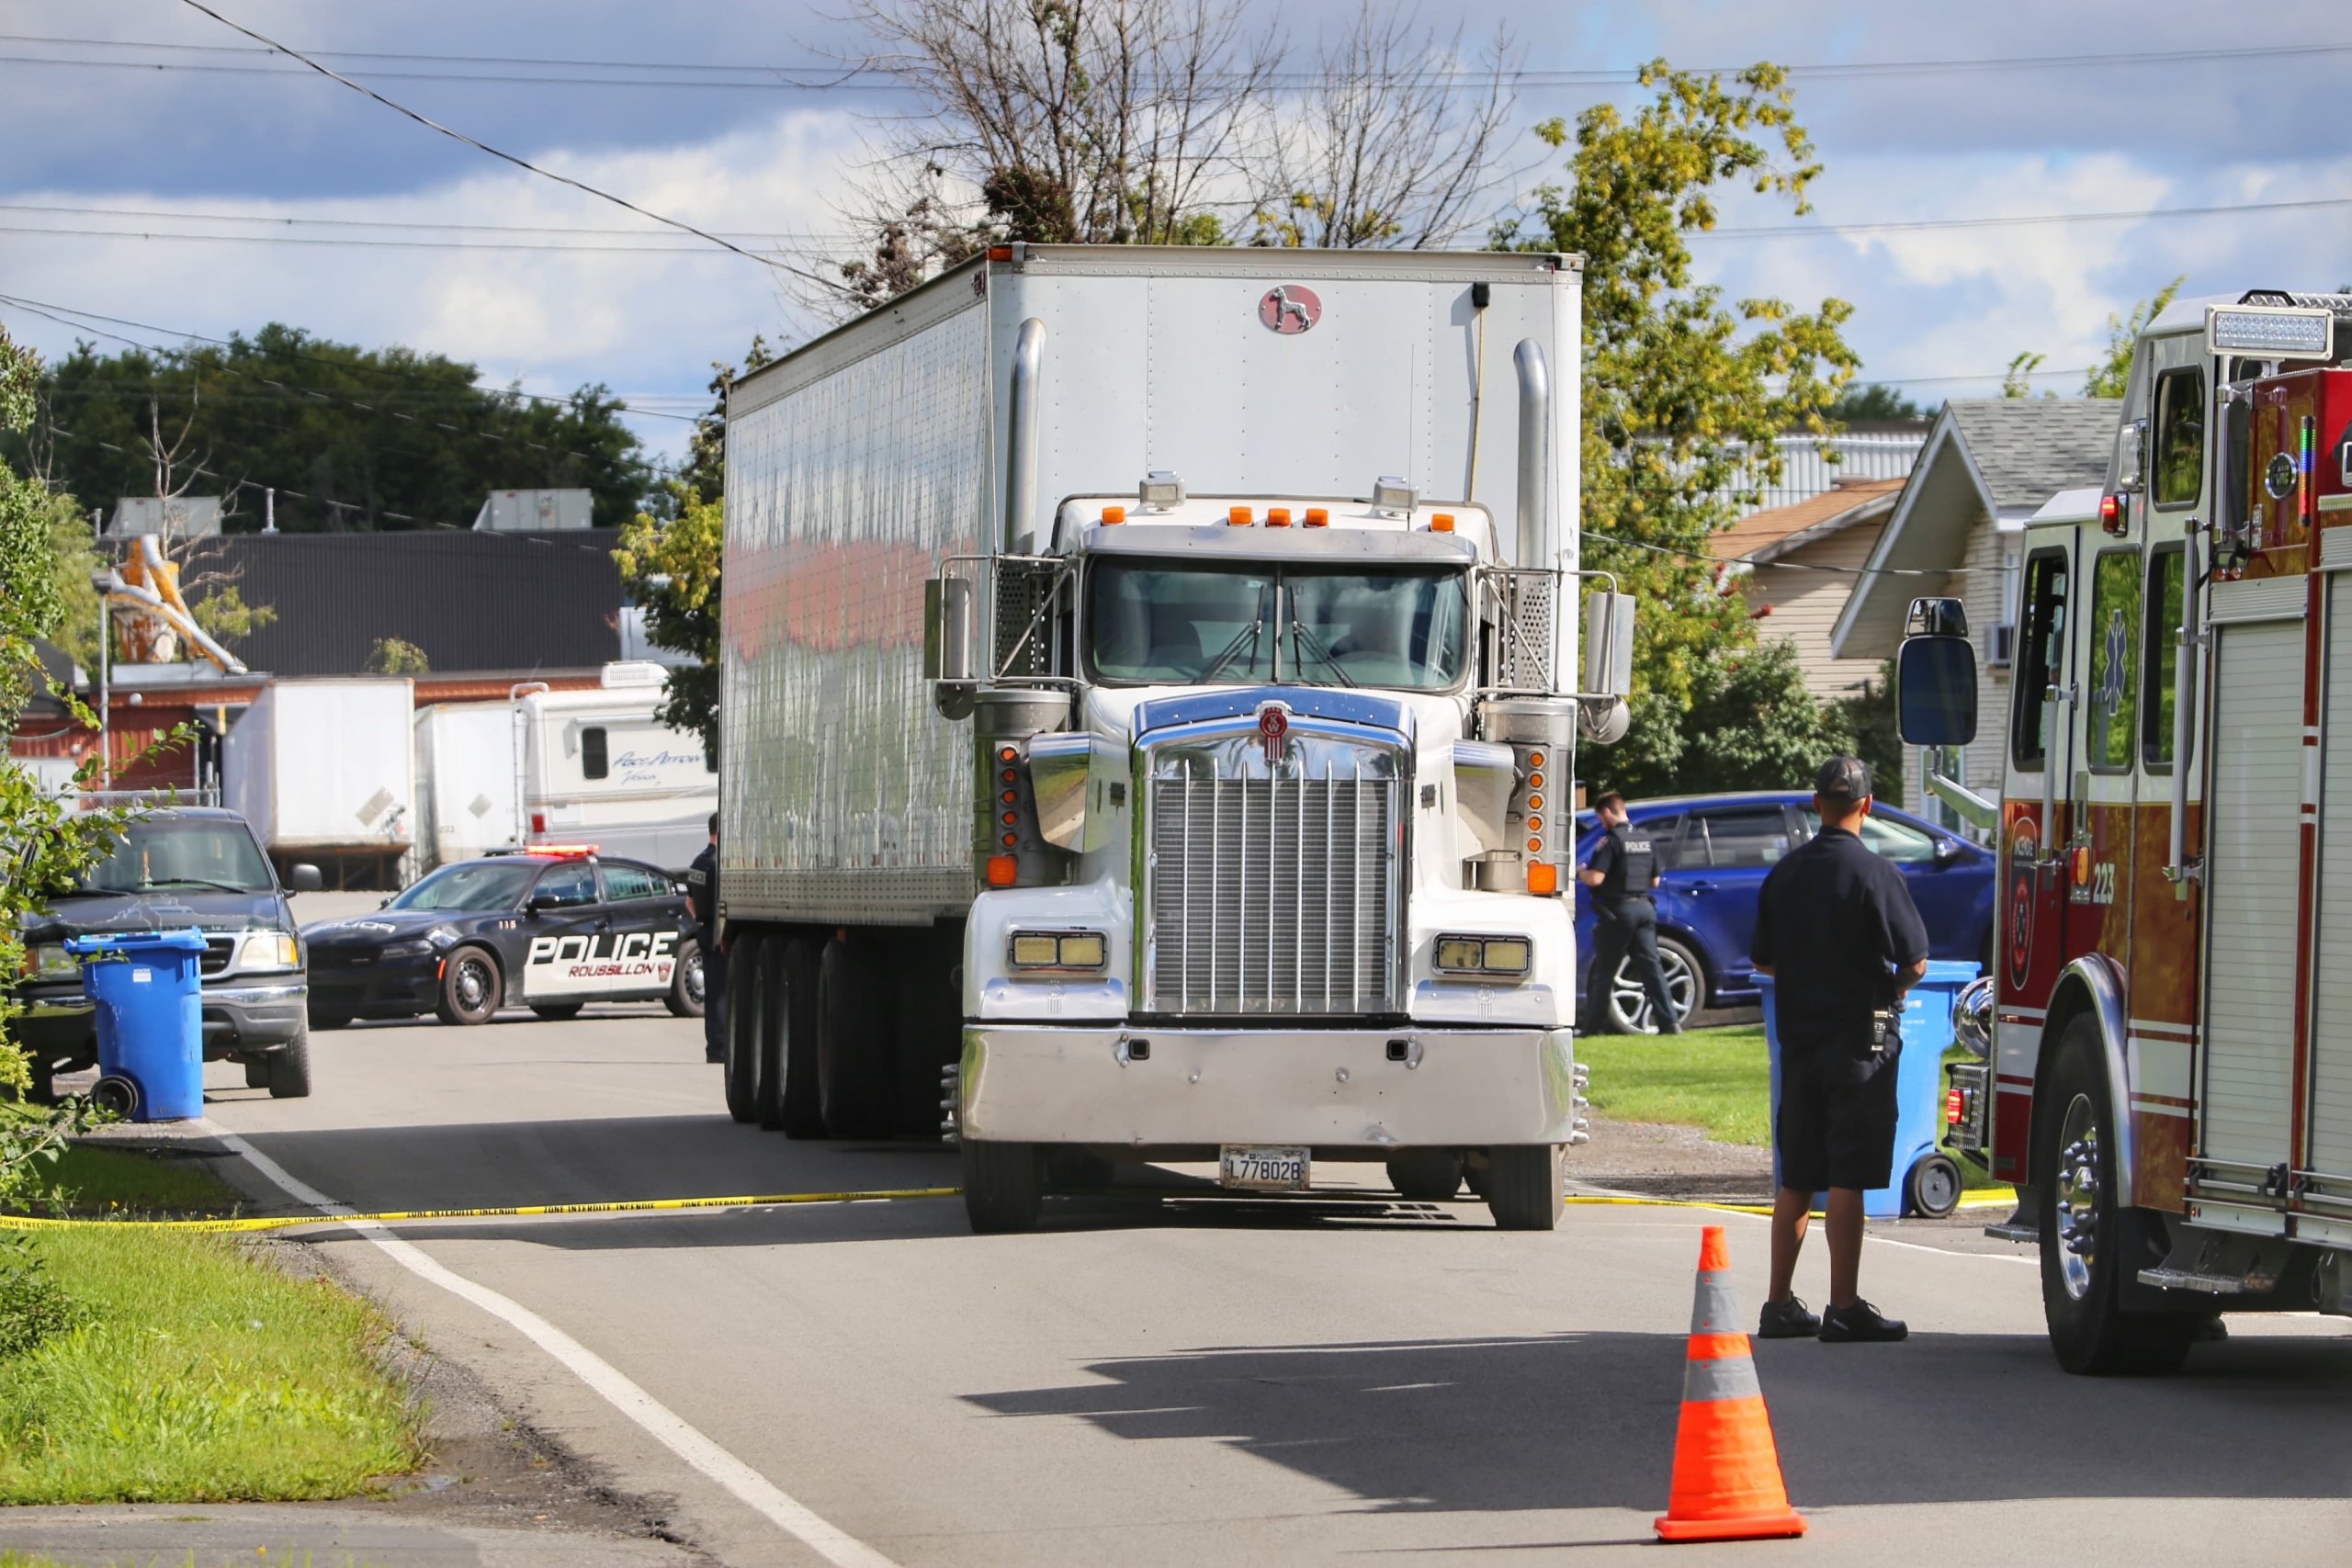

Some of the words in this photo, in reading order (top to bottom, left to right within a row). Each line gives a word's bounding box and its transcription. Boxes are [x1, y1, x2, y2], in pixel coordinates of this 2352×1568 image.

[1624, 840, 1652, 853] POLICE
[2093, 863, 2116, 905] 223
[498, 920, 516, 930] 115
[526, 931, 679, 965] POLICE
[569, 963, 655, 977] ROUSSILLON
[1229, 1160, 1301, 1180] L778028
[544, 1205, 565, 1213] ZONE
[568, 1203, 611, 1213] INTERDITE
[616, 1202, 655, 1211] INCENDIE
